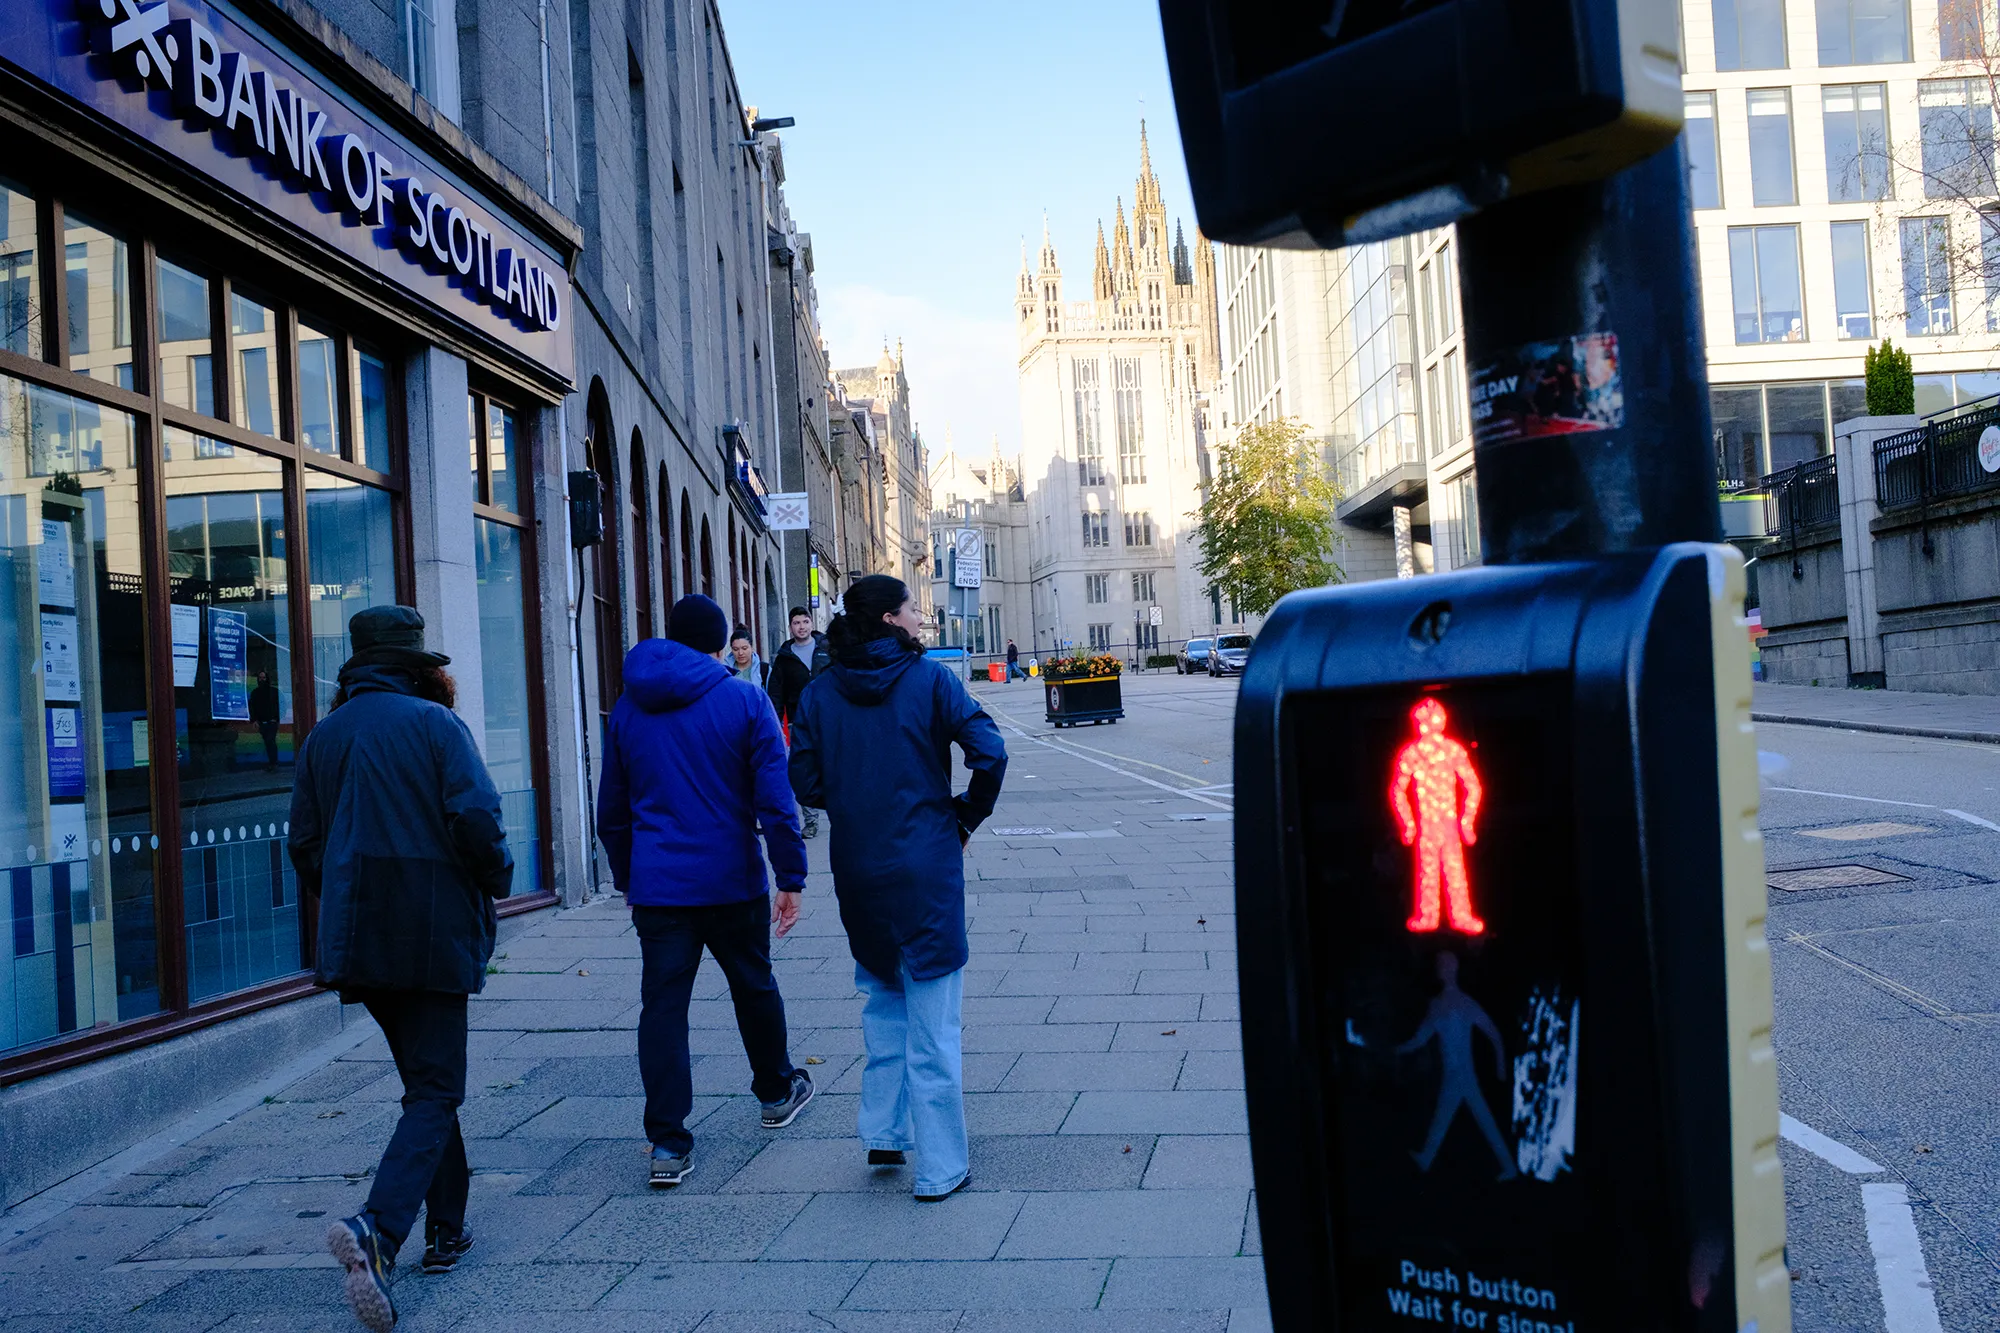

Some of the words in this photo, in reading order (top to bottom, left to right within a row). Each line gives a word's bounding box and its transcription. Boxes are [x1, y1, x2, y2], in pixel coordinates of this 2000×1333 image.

[191, 18, 331, 191] BANK
[341, 133, 394, 225] OF
[407, 177, 561, 332] SCOTLAND
[1488, 376, 1518, 397] DAY
[959, 577, 978, 585] ENDS
[1400, 1259, 1460, 1294] Push
[1467, 1271, 1556, 1311] button
[1387, 1287, 1443, 1323] Wait
[1452, 1300, 1488, 1330] for
